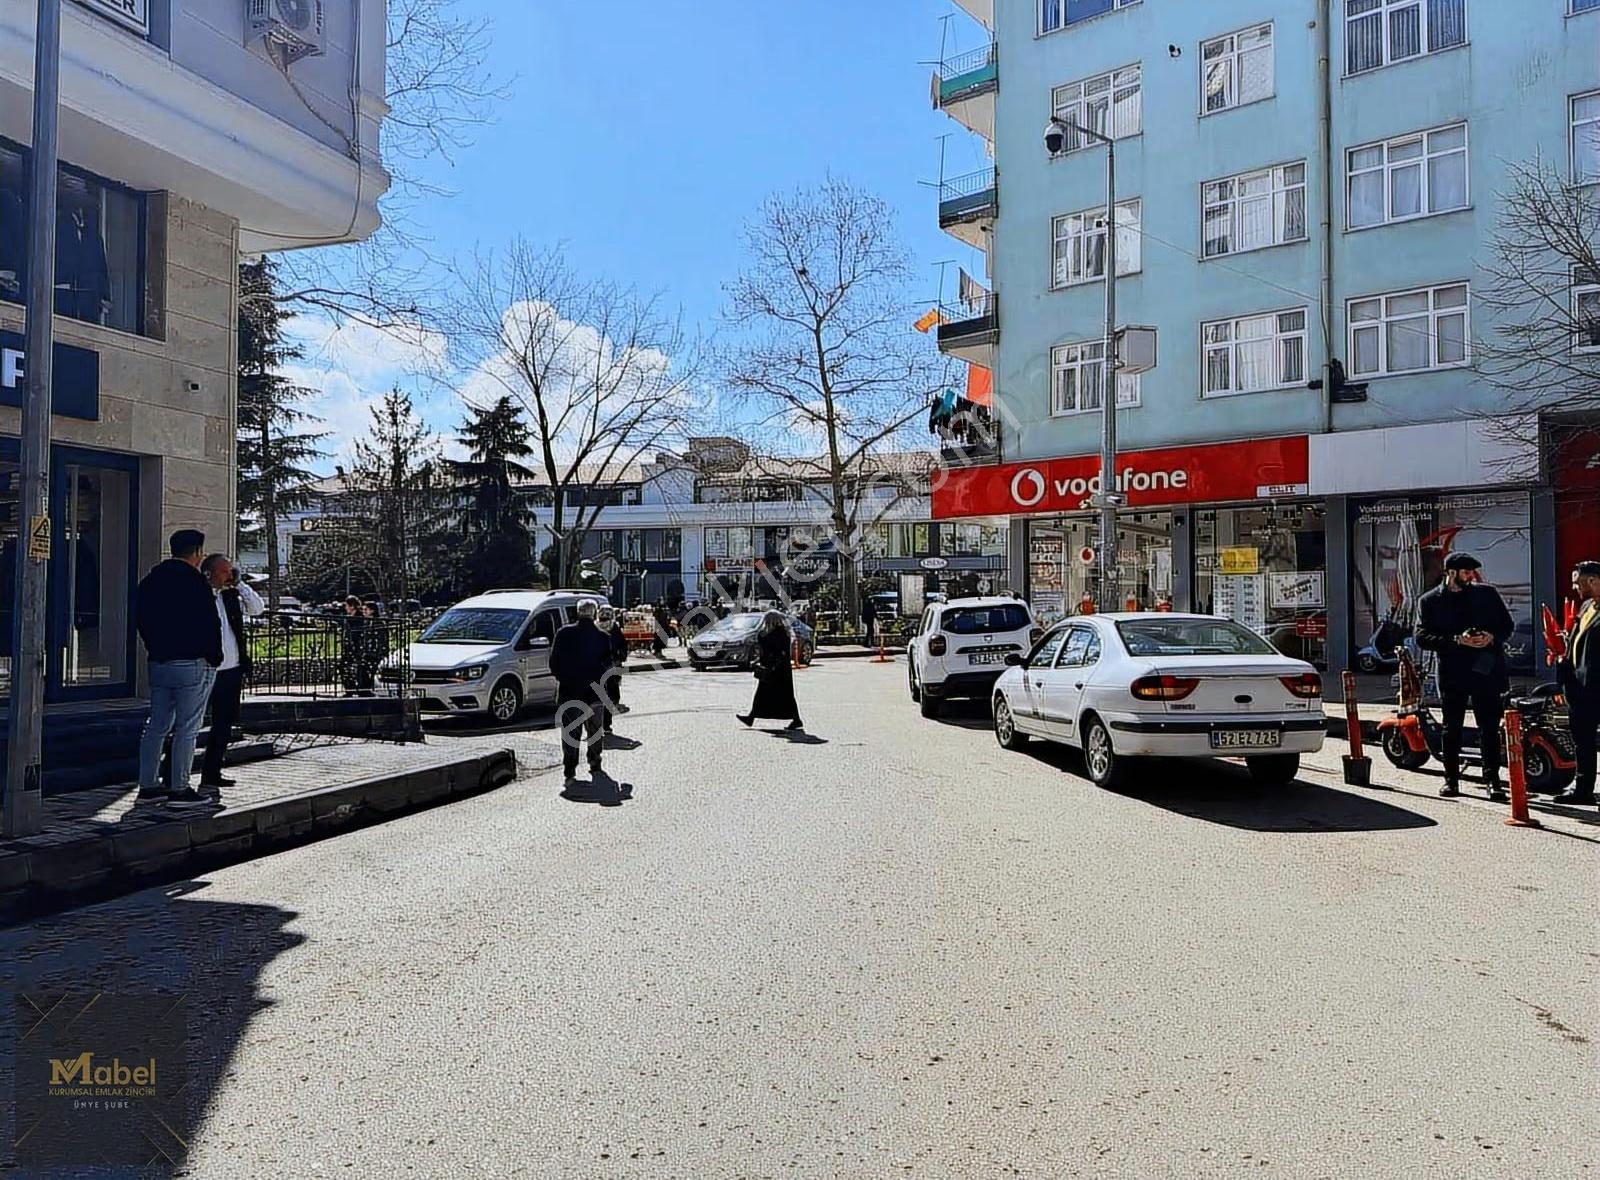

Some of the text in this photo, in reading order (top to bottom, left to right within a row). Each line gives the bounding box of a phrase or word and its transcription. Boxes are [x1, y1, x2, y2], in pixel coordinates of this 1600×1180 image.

[1054, 467, 1187, 497] vodfone
[1221, 732, 1235, 746] 52
[1253, 731, 1276, 745] 725
